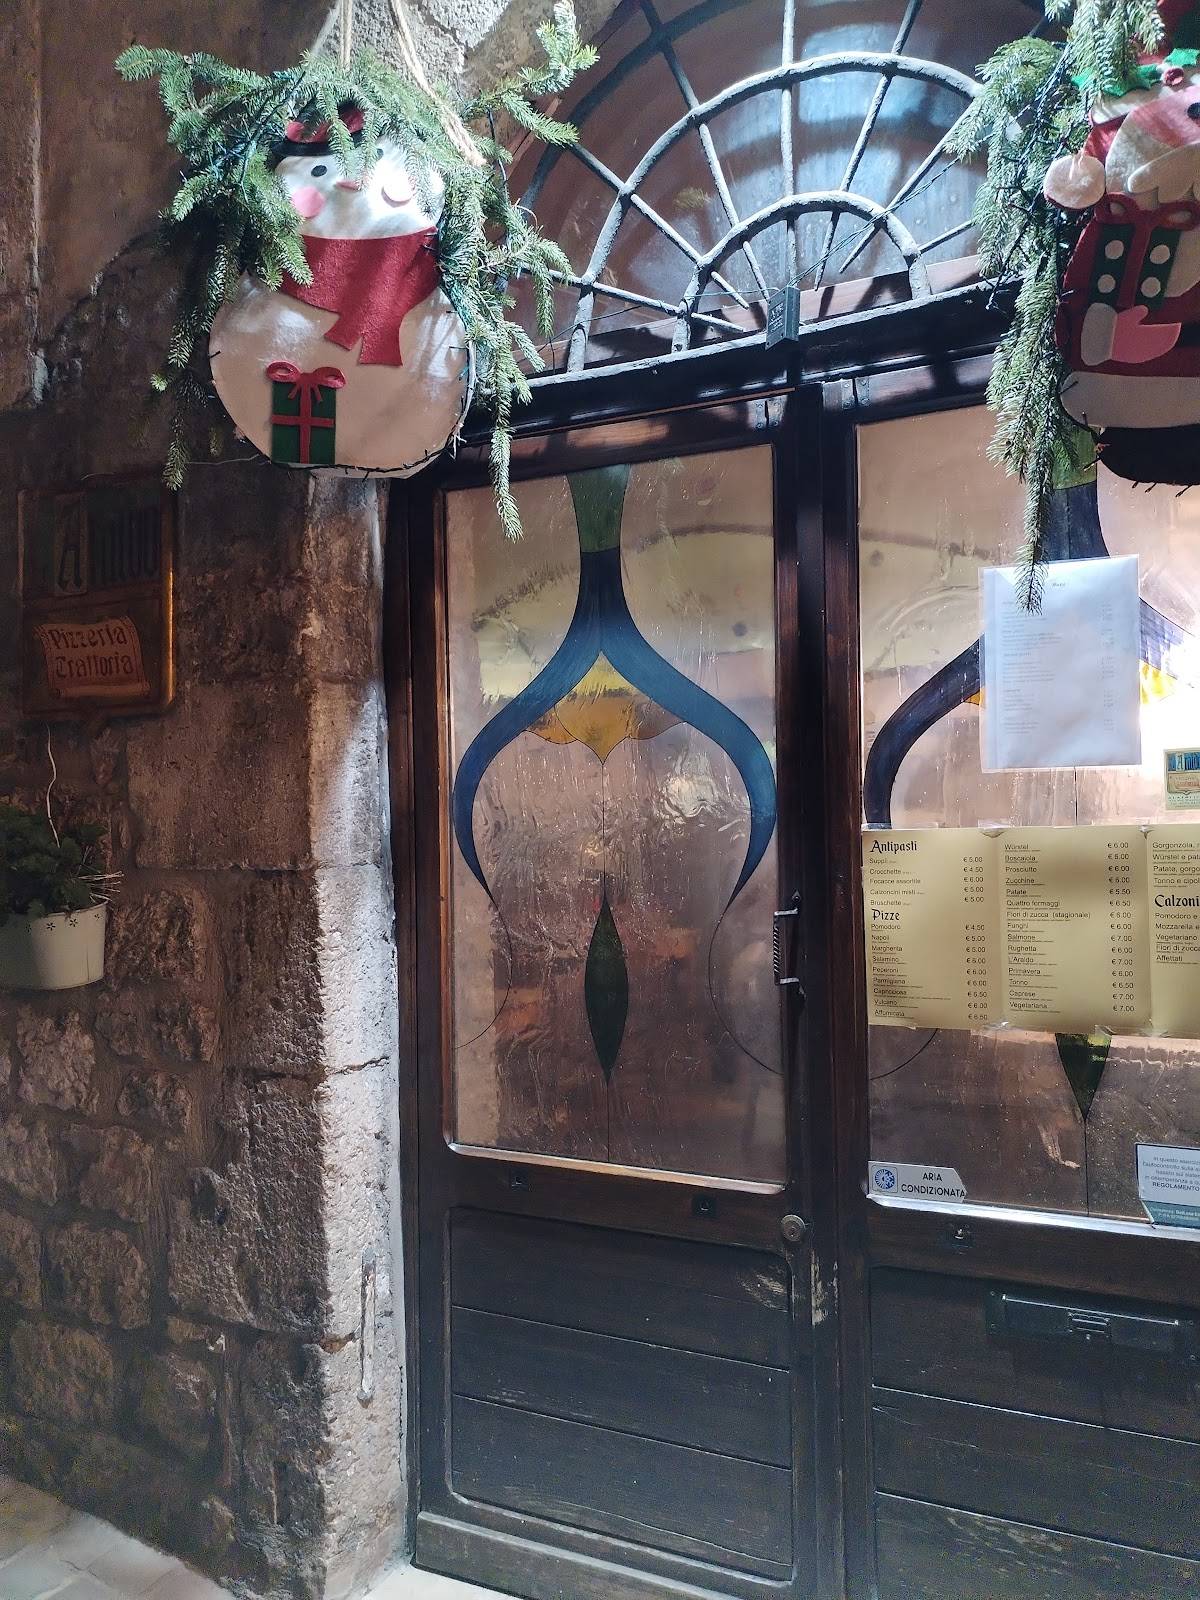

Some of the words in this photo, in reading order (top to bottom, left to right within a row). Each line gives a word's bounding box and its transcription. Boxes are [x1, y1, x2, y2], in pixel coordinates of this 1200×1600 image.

[49, 625, 128, 649] Pizzeria
[55, 651, 134, 678] Trattoria
[869, 840, 917, 854] Antipasti
[1154, 894, 1200, 908] Calzoni
[871, 908, 900, 921] Pizze
[1156, 933, 1198, 941] Vegetariano
[922, 1172, 943, 1181] ARIA
[901, 1183, 965, 1198] CONDIZIONATA
[1152, 1182, 1200, 1191] REGOLAMENTO
